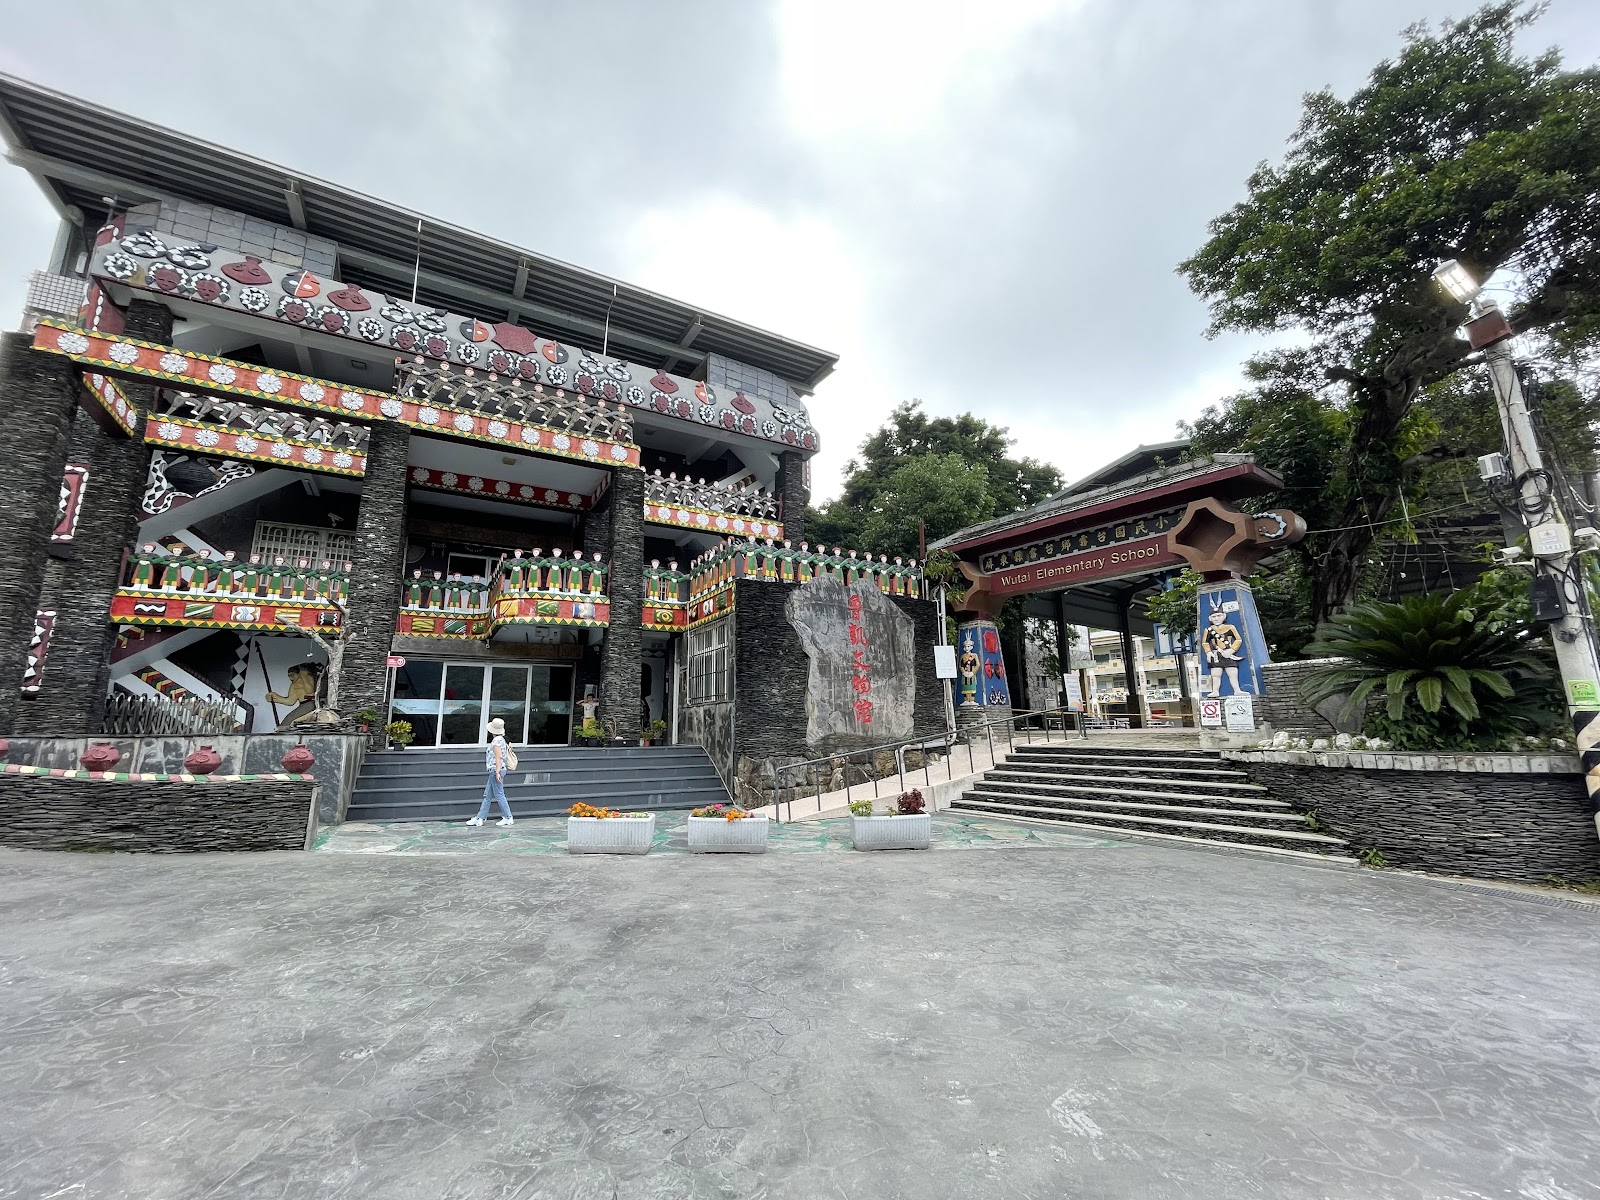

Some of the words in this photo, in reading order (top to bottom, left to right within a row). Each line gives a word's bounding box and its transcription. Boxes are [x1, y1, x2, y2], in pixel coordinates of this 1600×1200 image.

[1000, 571, 1031, 586] Wutai
[1036, 557, 1105, 579] Elementary
[1111, 543, 1160, 564] School
